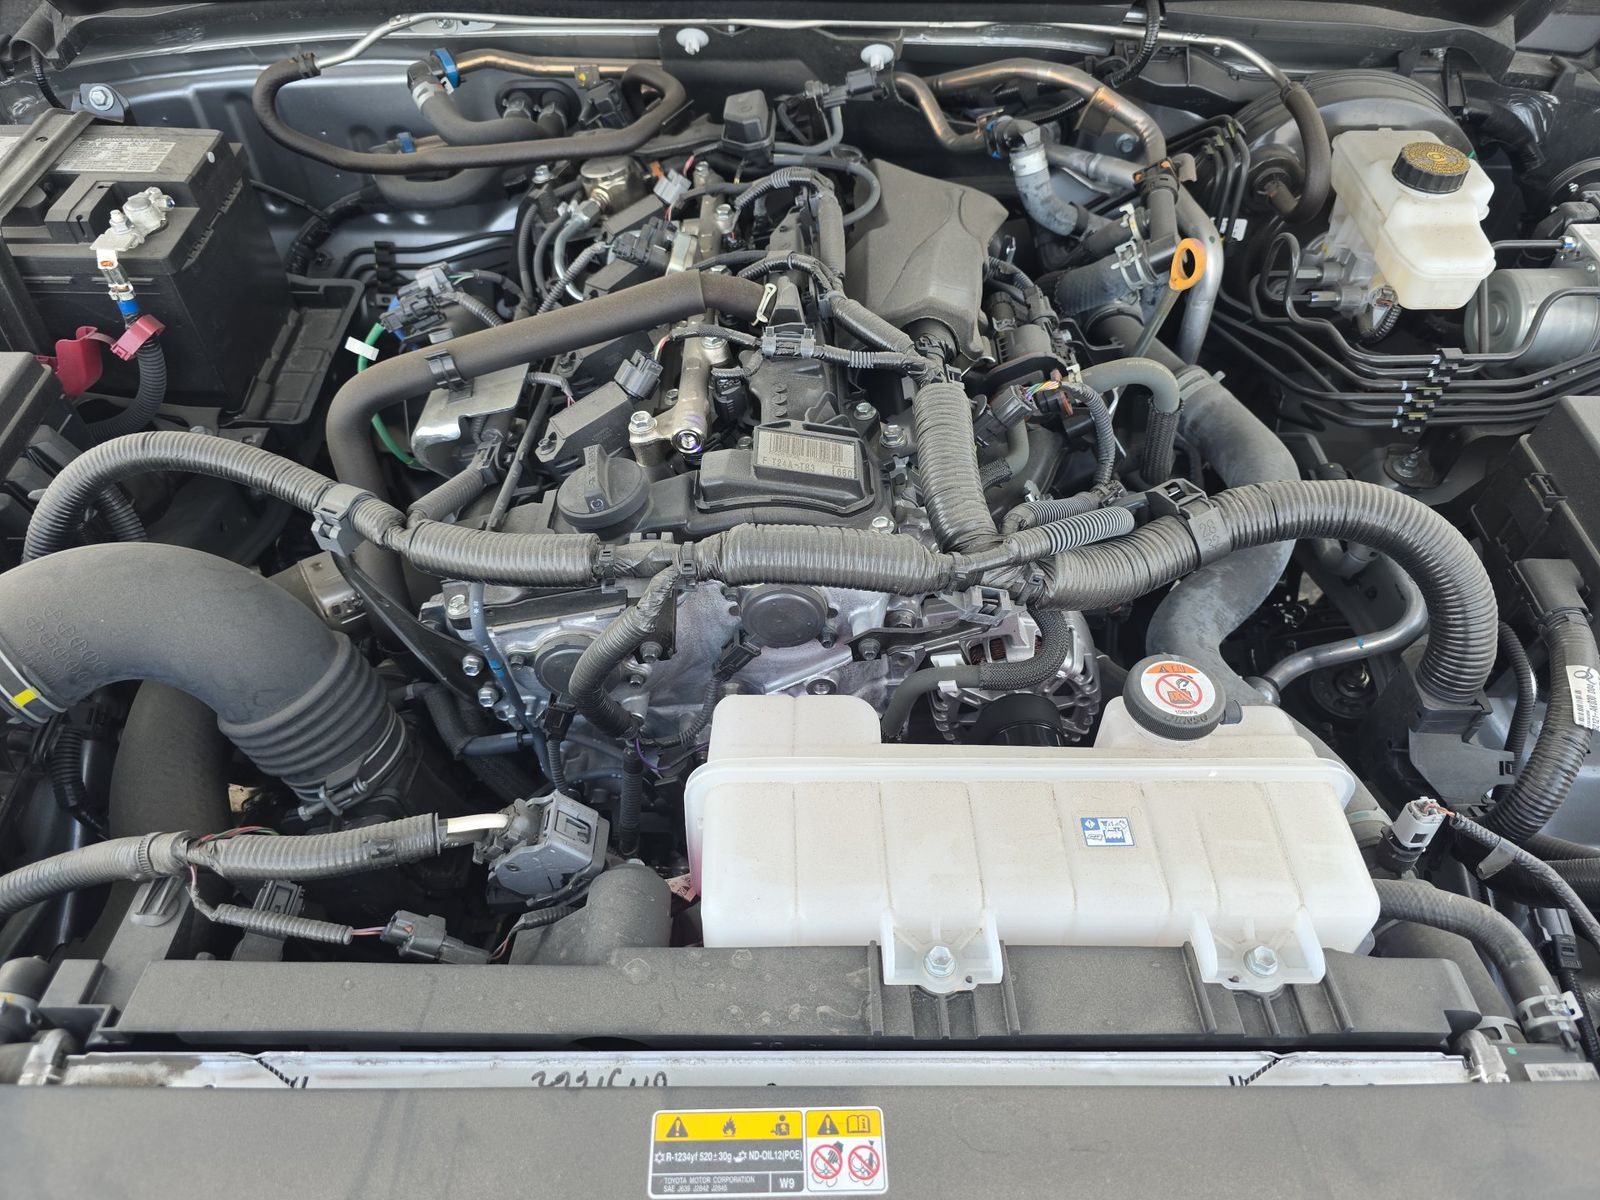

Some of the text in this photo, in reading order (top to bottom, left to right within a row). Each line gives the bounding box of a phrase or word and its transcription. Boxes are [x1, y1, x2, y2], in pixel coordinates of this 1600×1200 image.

[665, 1151, 698, 1164] R-1234yf
[664, 1175, 756, 1185] TOYOTA MOTOR CORPORATION
[779, 1177, 796, 1189] W9
